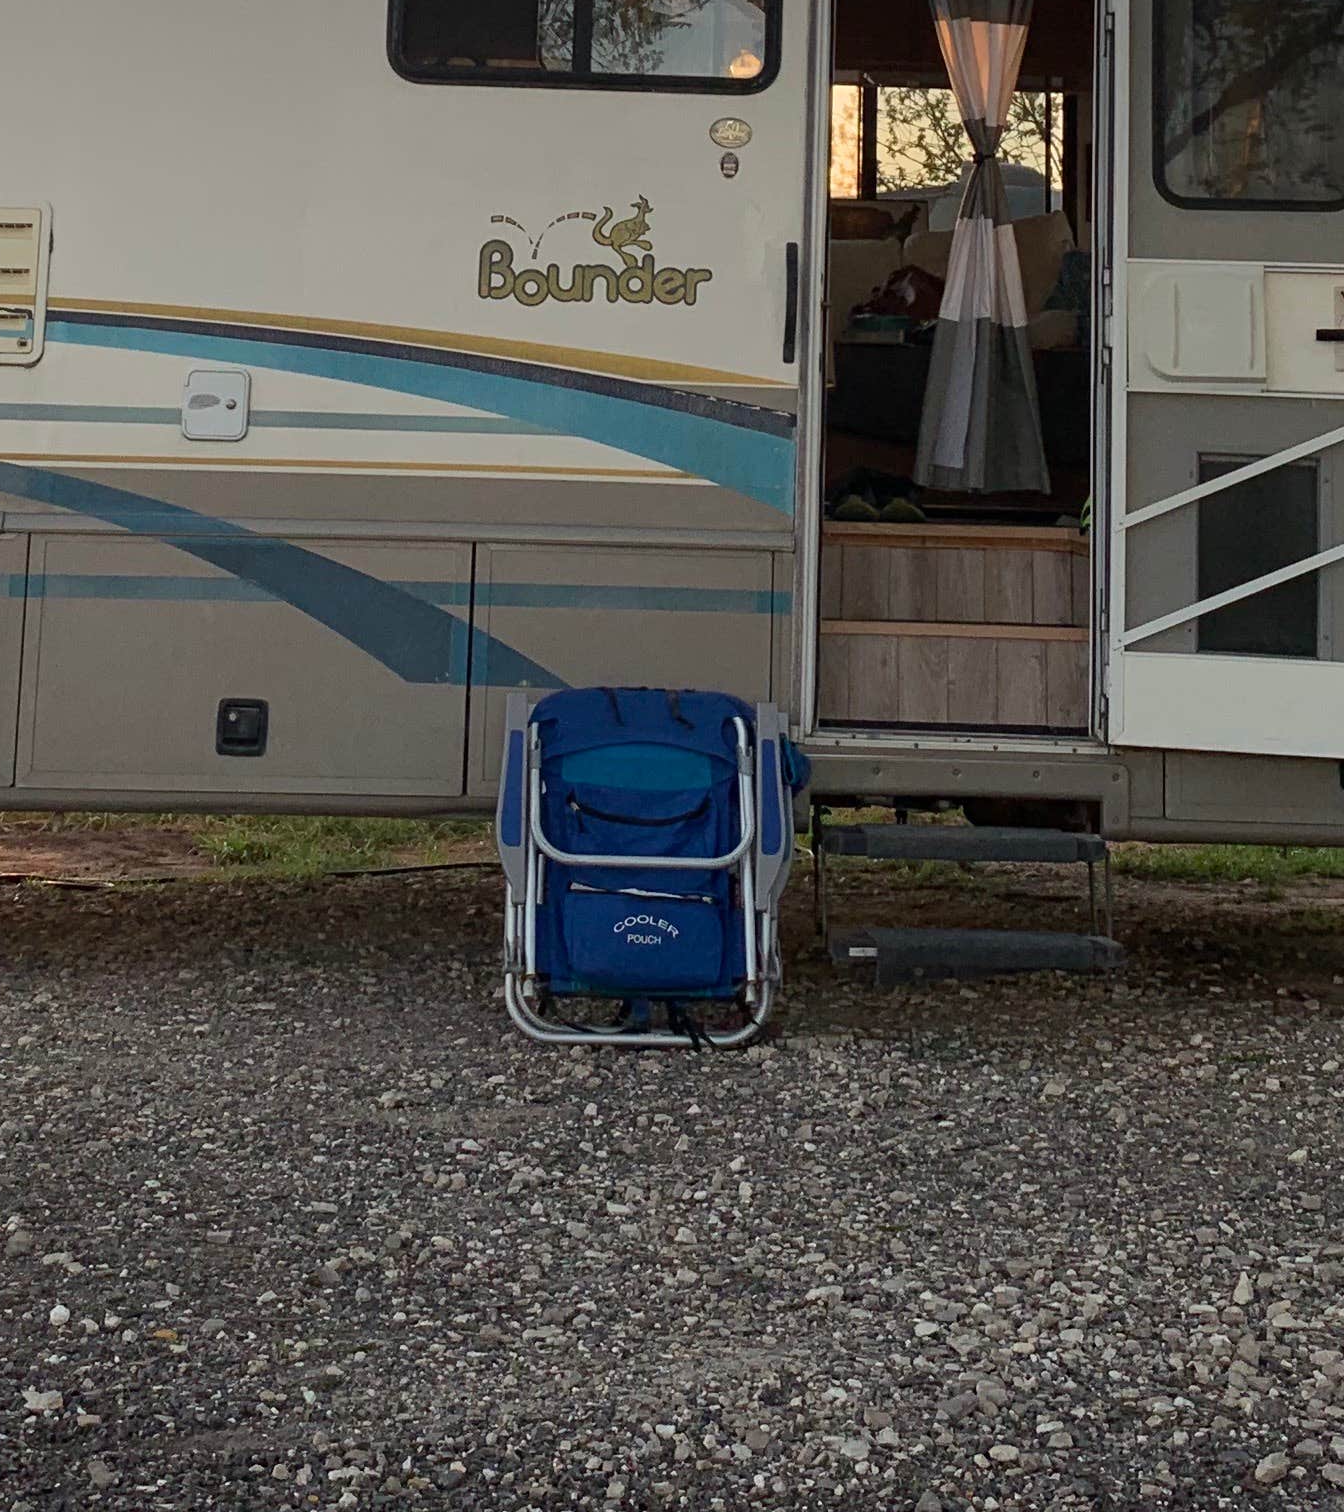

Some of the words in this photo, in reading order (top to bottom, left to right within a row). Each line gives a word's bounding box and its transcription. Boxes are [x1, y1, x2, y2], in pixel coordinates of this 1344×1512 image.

[478, 239, 713, 306] Bounder
[613, 914, 680, 938] COOLER
[626, 933, 662, 945] POUCH
